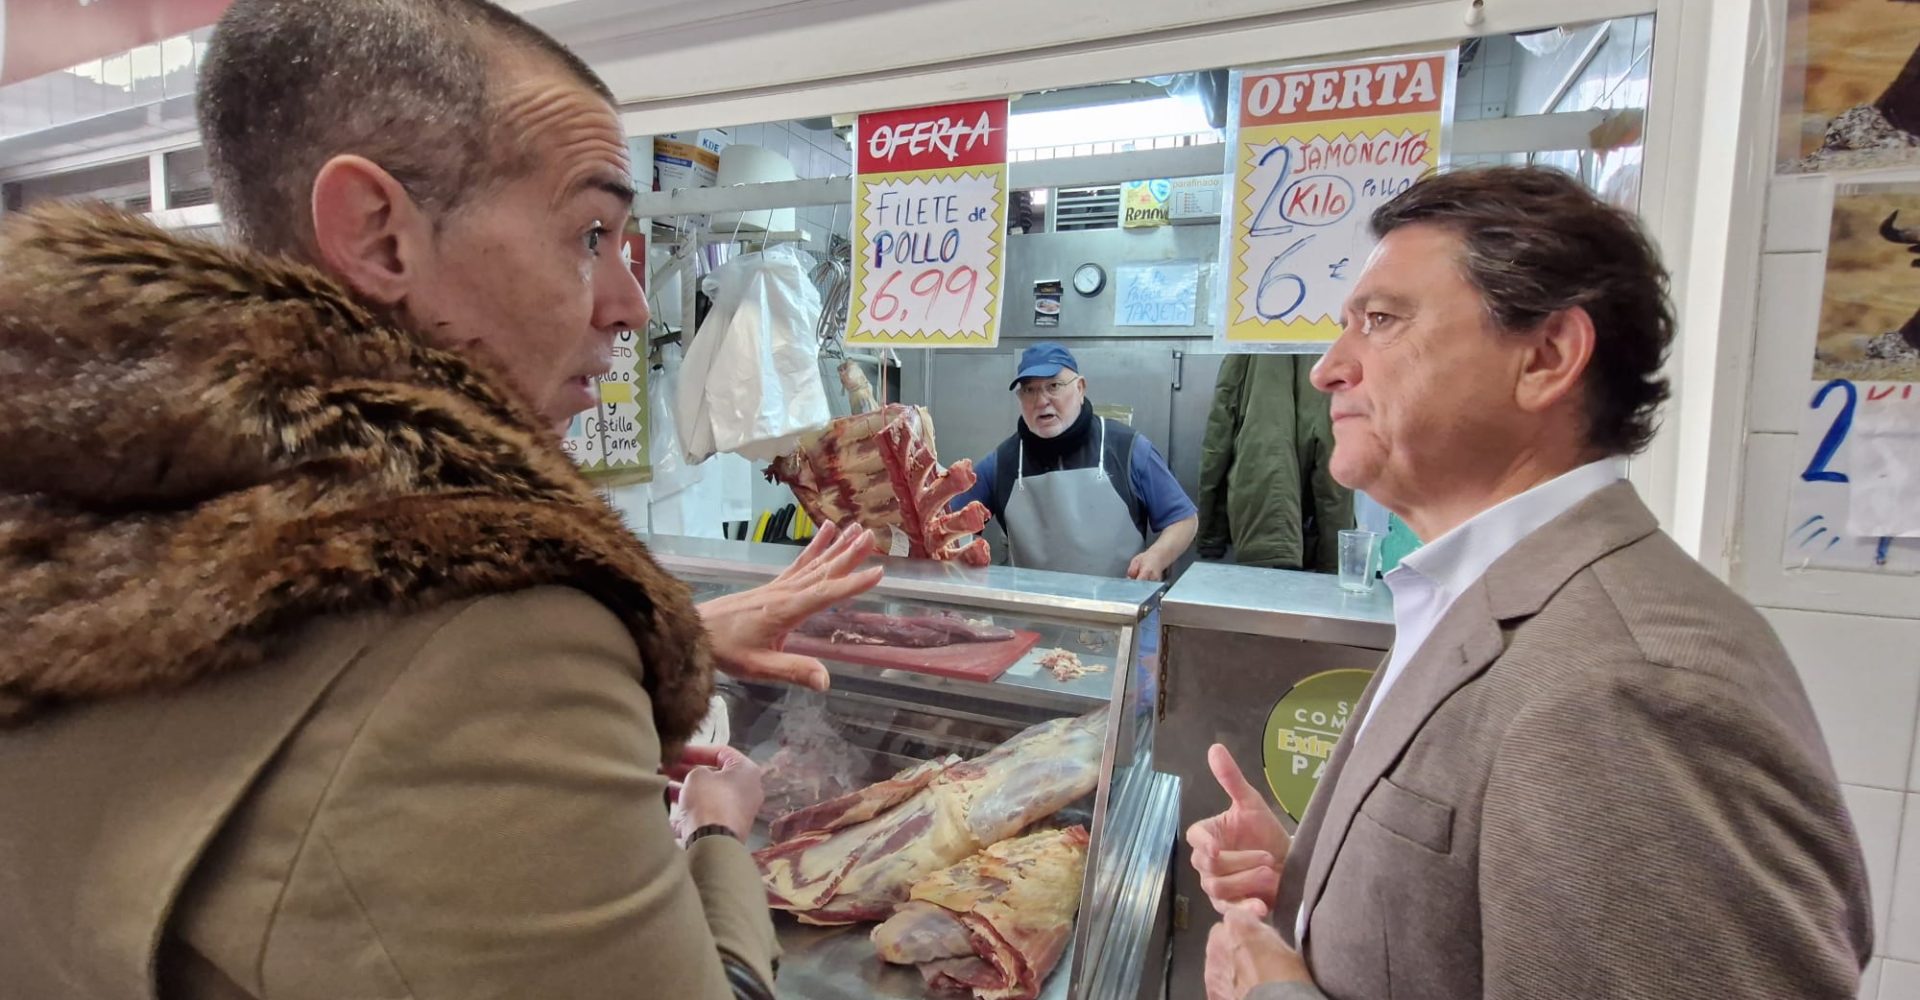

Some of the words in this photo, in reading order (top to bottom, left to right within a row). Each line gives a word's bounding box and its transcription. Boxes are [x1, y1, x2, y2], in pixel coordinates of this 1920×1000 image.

[1247, 61, 1436, 117] OFERTA
[702, 137, 720, 153] KDE
[867, 111, 1002, 162] OFERTA
[1293, 134, 1427, 174] JAMONCITO
[876, 192, 959, 226] FILETE
[968, 207, 987, 222] de
[1250, 145, 1293, 237] 2
[1286, 182, 1346, 218] Kilo
[1125, 207, 1169, 222] Renov
[873, 228, 960, 268] POLLO
[1256, 234, 1316, 319] 6
[870, 265, 978, 328] 6,99
[610, 346, 632, 358] ETO
[585, 416, 633, 439] Costilla
[1801, 378, 1857, 482] 2
[1294, 708, 1347, 729] COM
[1278, 728, 1336, 758] Extr
[1292, 754, 1328, 780] PA
